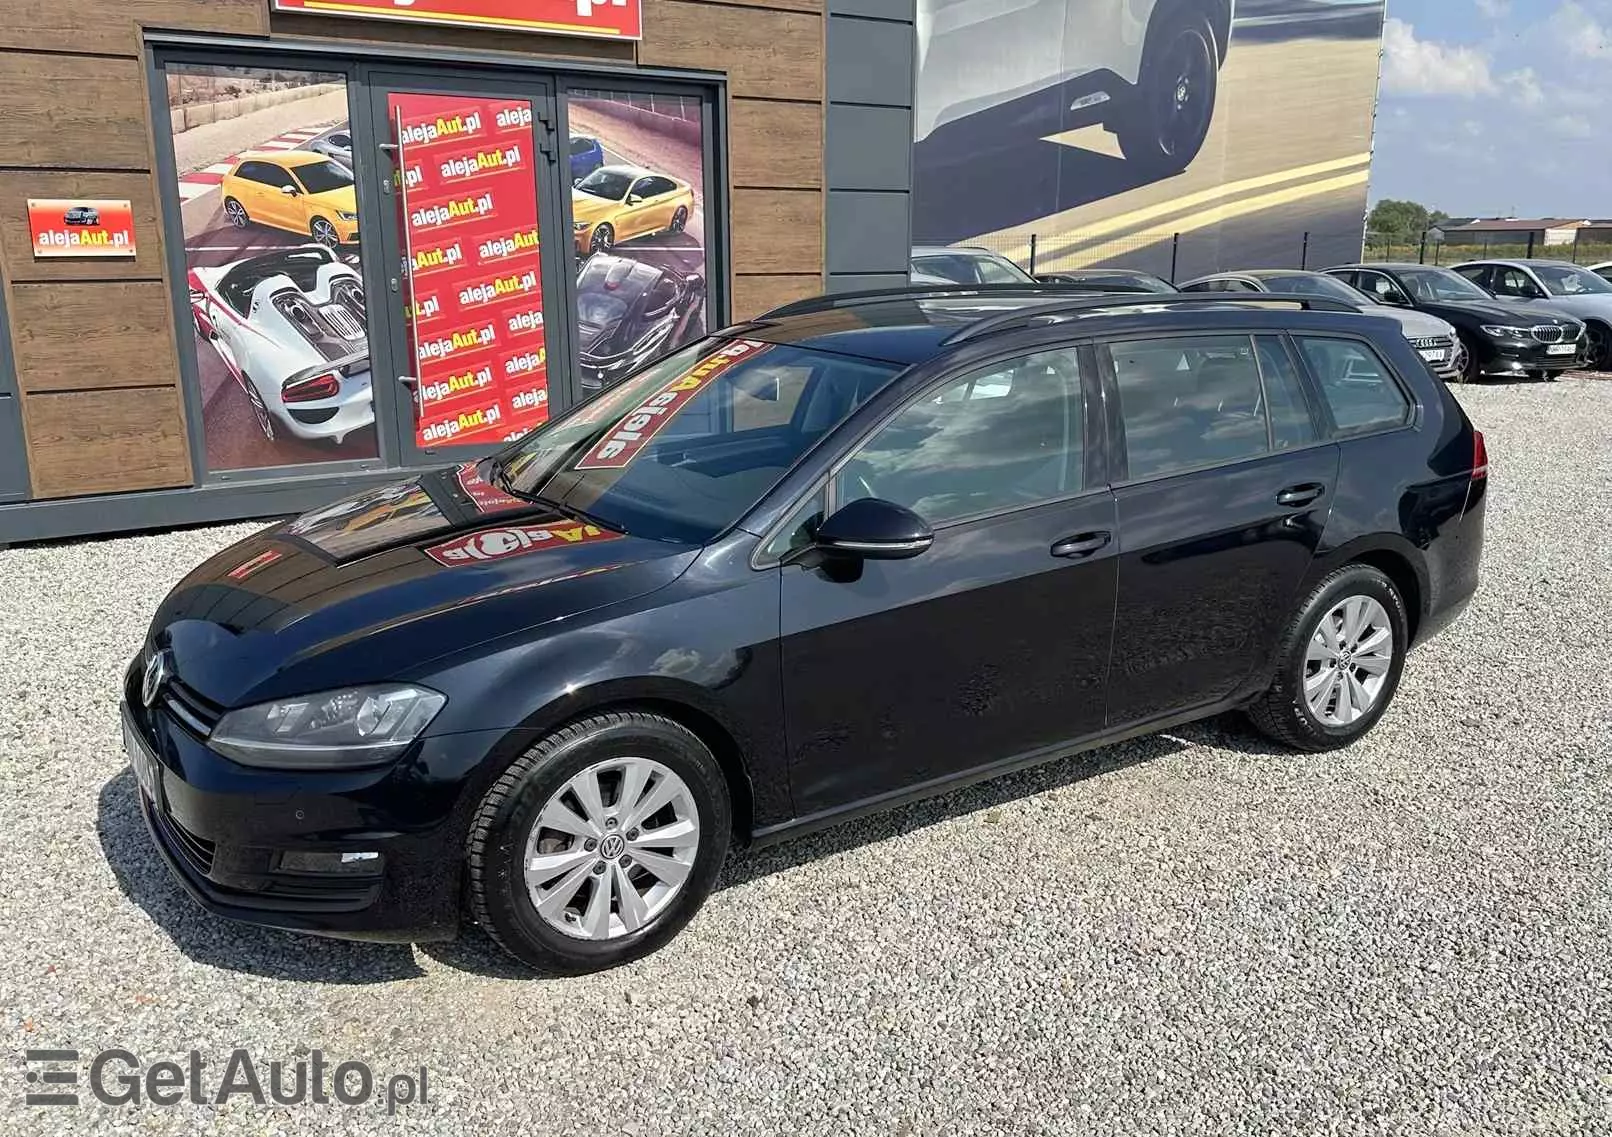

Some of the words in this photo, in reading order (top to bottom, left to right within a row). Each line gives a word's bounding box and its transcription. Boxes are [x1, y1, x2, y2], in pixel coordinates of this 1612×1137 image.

[496, 106, 532, 127] aleja
[441, 146, 520, 177] alejaAut.pl
[411, 193, 493, 226] alejaAut.pl
[39, 229, 128, 248] alejaAut.pl
[459, 271, 536, 305] alejaAut.pl
[508, 310, 543, 331] aleja
[422, 404, 501, 441] alejaAut.pl
